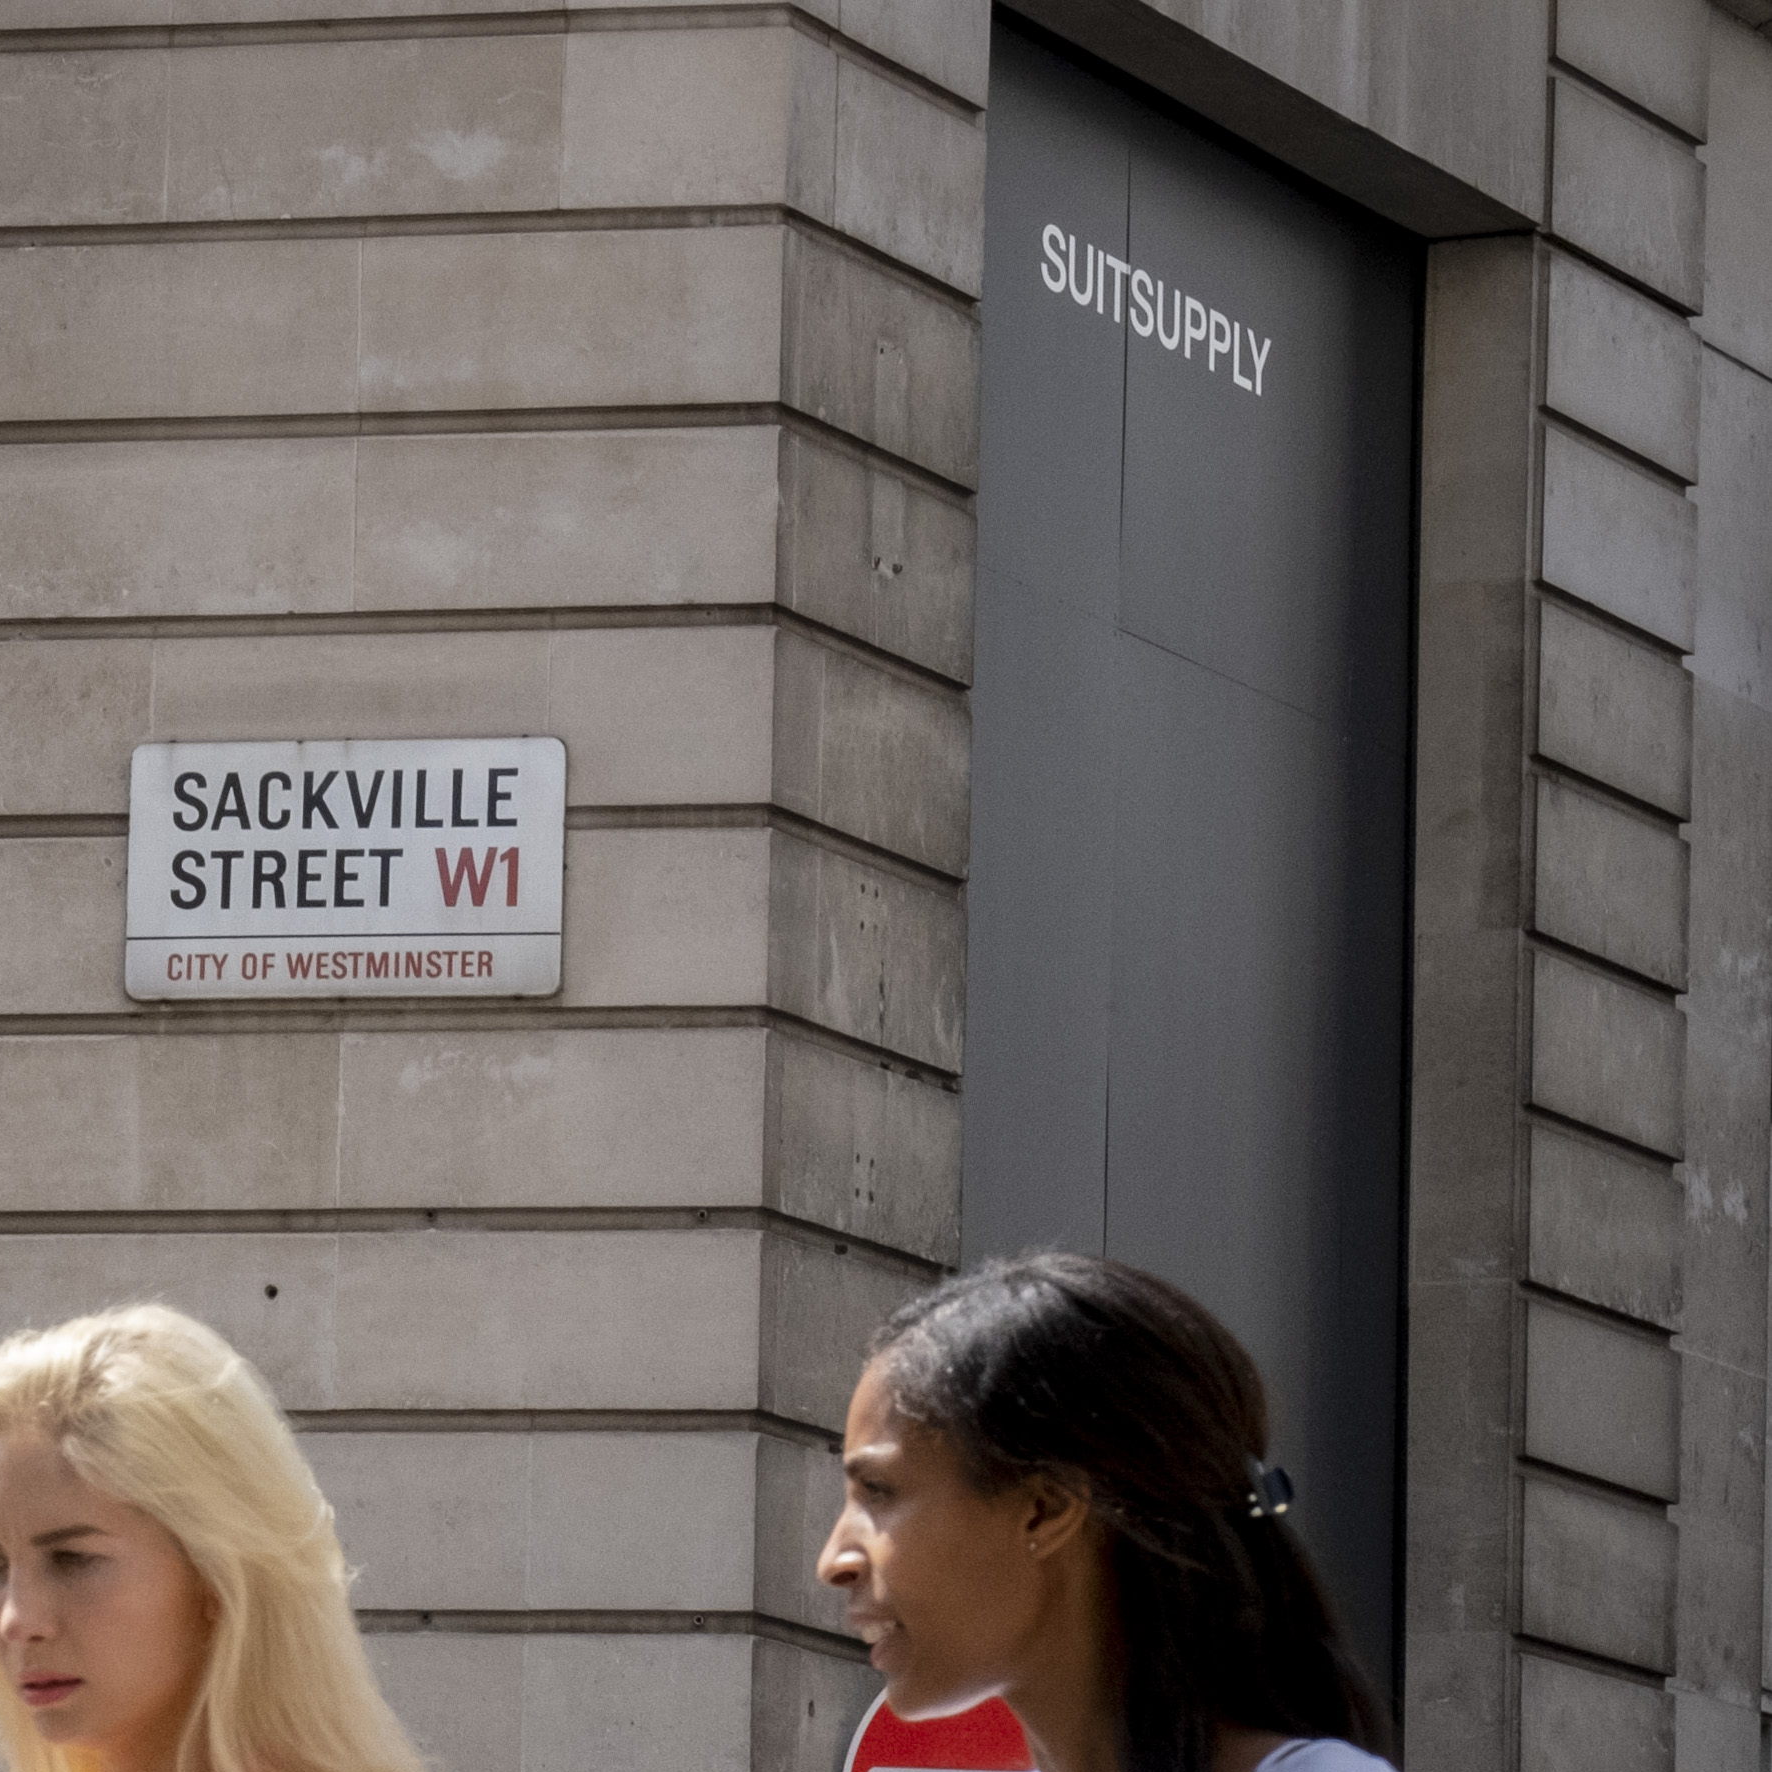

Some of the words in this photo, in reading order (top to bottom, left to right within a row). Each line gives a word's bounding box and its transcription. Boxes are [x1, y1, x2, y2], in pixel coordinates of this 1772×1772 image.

[1040, 223, 1272, 397] SUITSUPPLY
[171, 767, 520, 832] SACKVILLE
[169, 848, 404, 910] STREET
[434, 846, 520, 908] W1
[166, 953, 229, 982] CITY
[241, 952, 276, 981] OF
[286, 950, 494, 981] WESTMINSTER
